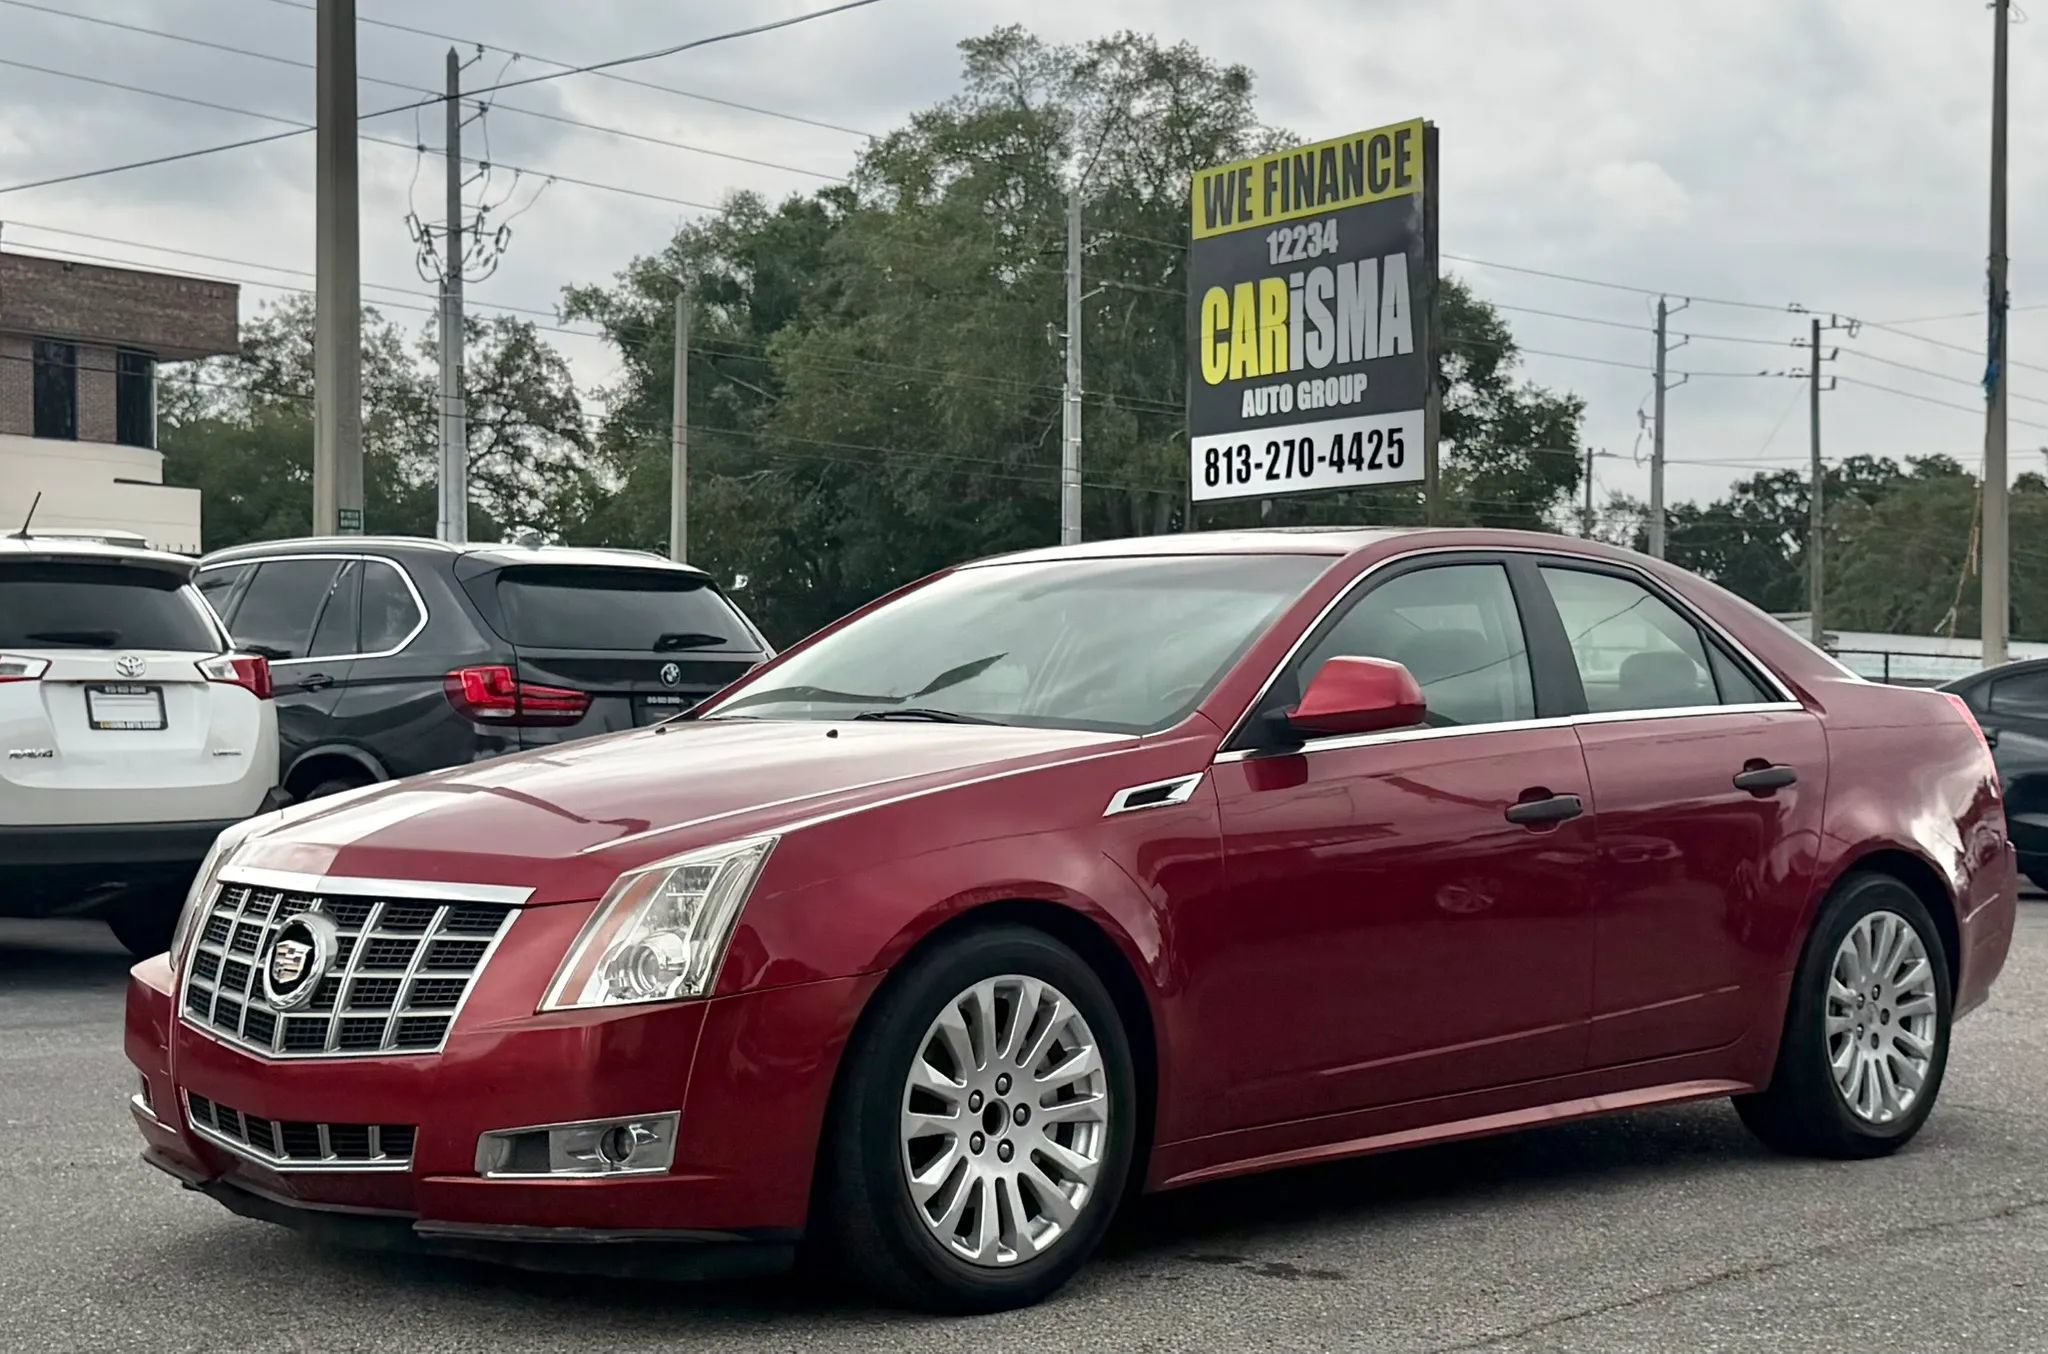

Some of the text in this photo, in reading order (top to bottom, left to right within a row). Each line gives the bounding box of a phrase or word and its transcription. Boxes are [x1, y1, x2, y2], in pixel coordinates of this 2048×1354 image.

[1203, 128, 1412, 230] WE FINANCE
[1266, 218, 1339, 265] 12234
[1241, 373, 1368, 418] AUTO GROUP
[1204, 427, 1405, 487] 813-270-4425
